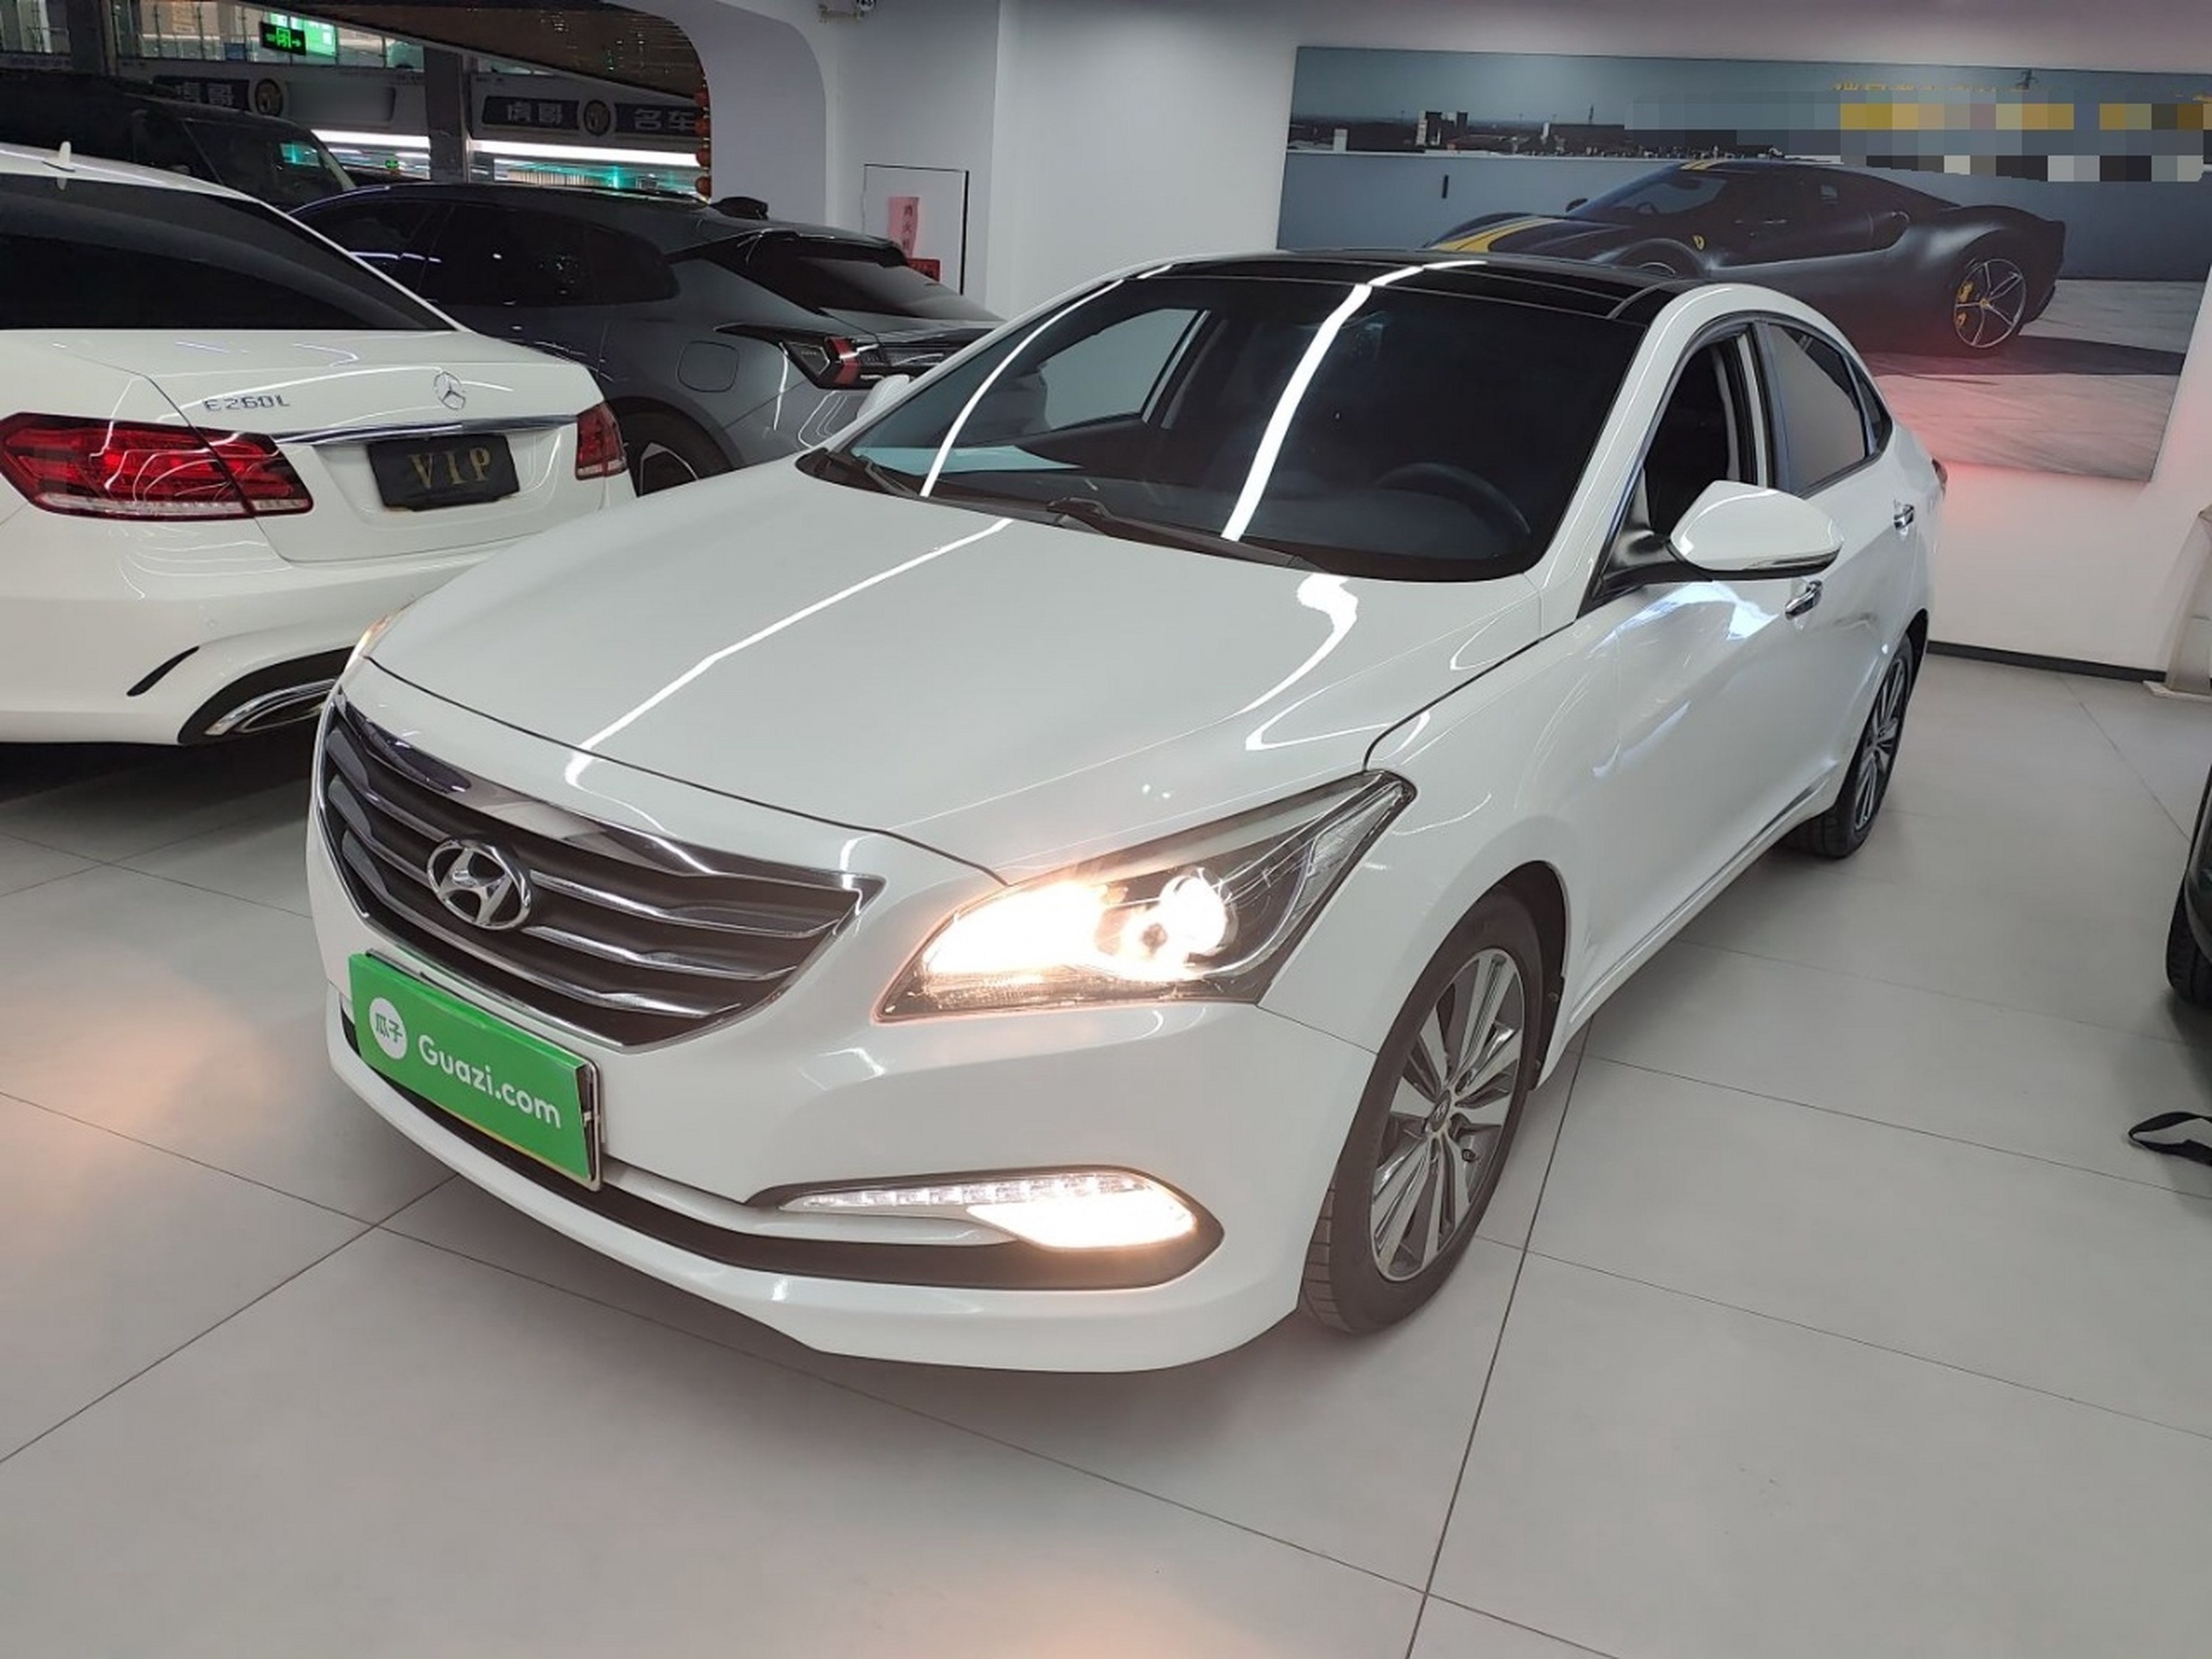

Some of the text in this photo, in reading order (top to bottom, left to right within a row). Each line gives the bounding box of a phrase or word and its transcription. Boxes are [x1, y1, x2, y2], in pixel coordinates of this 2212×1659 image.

[634, 108, 695, 131] 名车
[408, 446, 491, 490] VIP
[376, 1012, 403, 1043] 瓜子
[418, 1035, 561, 1128] Guazi.com
